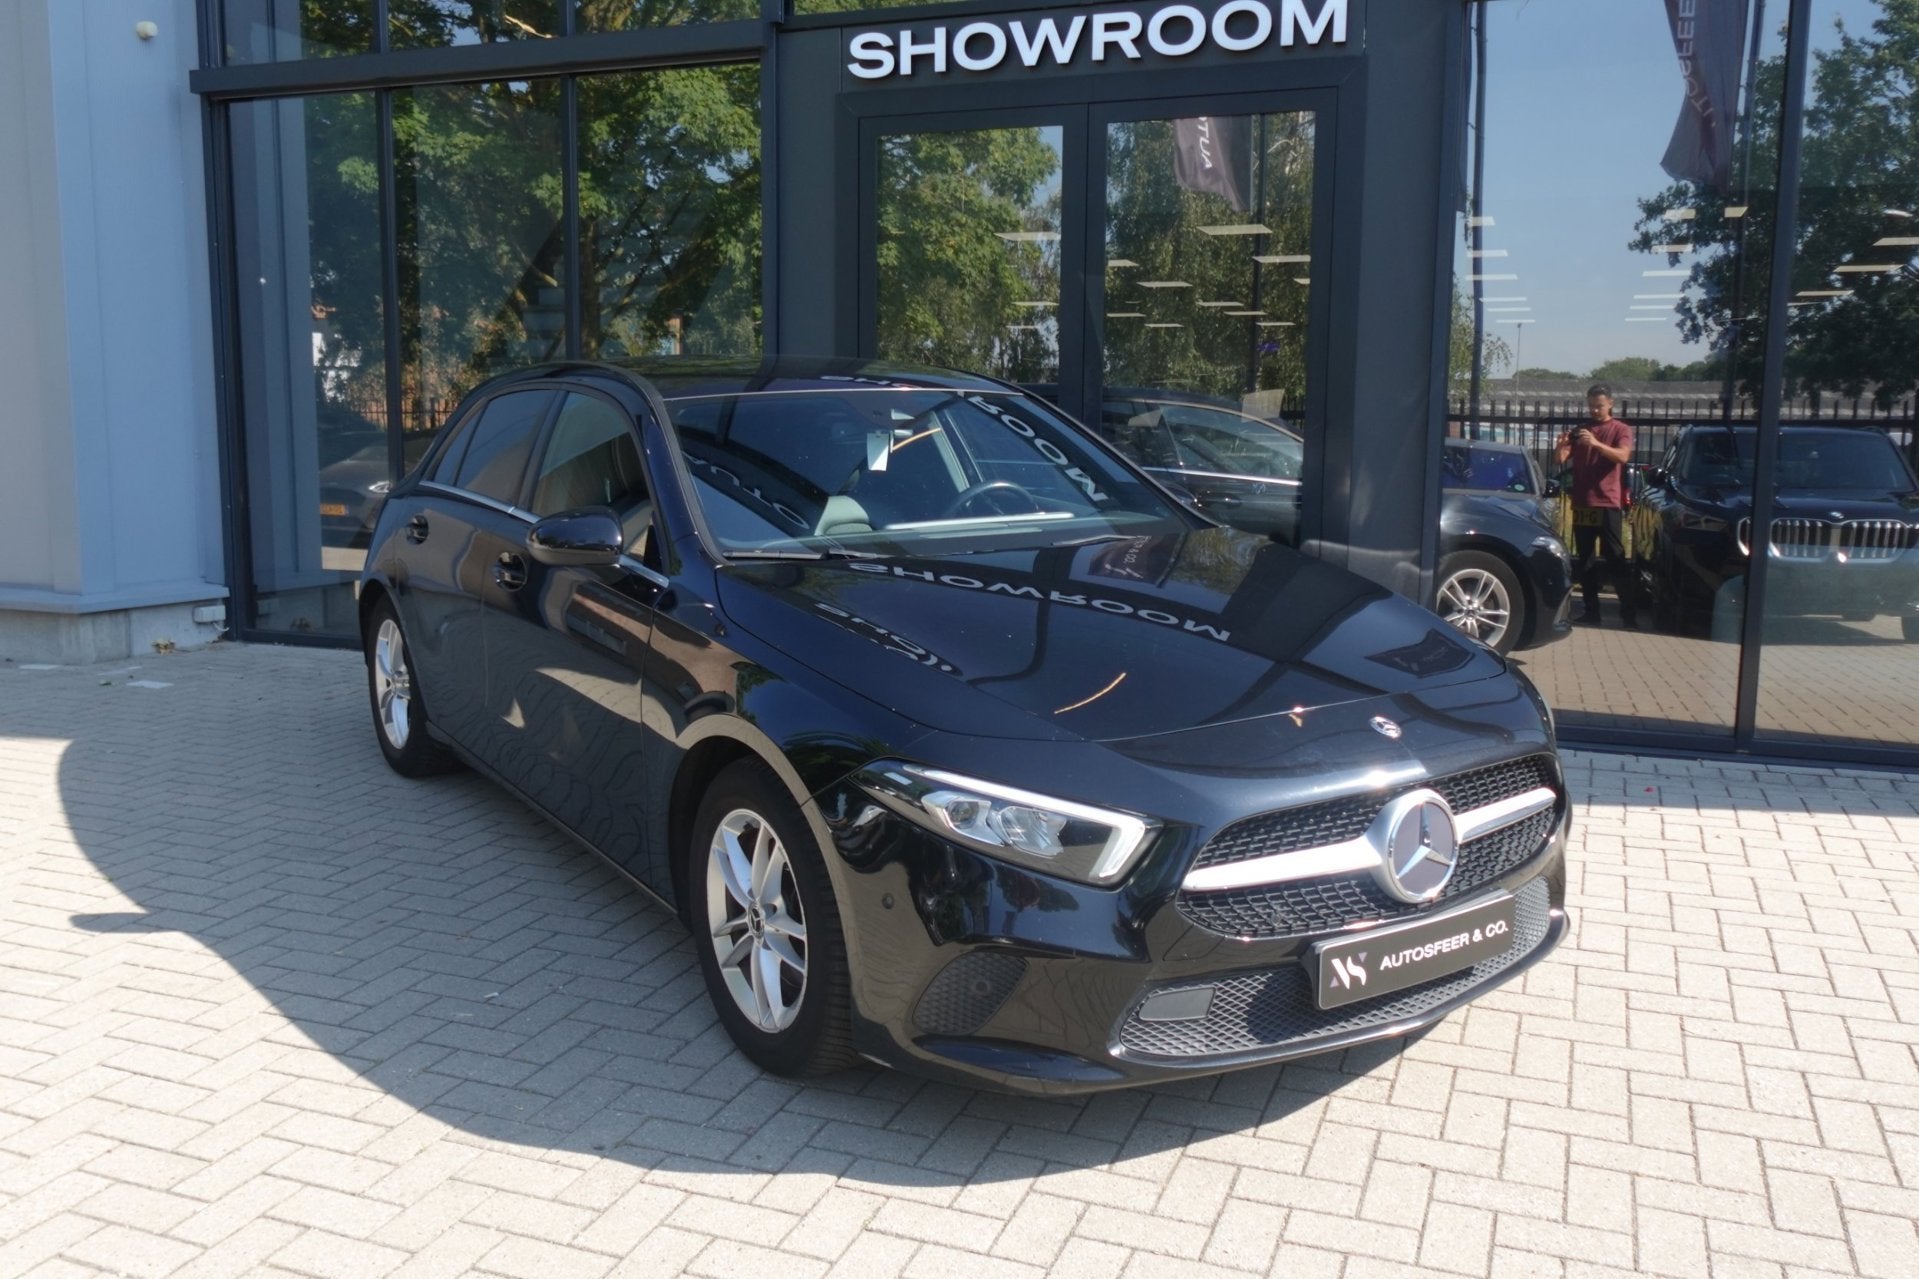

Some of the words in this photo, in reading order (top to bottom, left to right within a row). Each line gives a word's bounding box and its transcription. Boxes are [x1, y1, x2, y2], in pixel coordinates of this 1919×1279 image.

[847, 0, 1348, 80] SHOWROOM
[1379, 932, 1470, 971] AUTOSFEER
[1472, 928, 1484, 943] &
[1485, 920, 1508, 937] CO.
